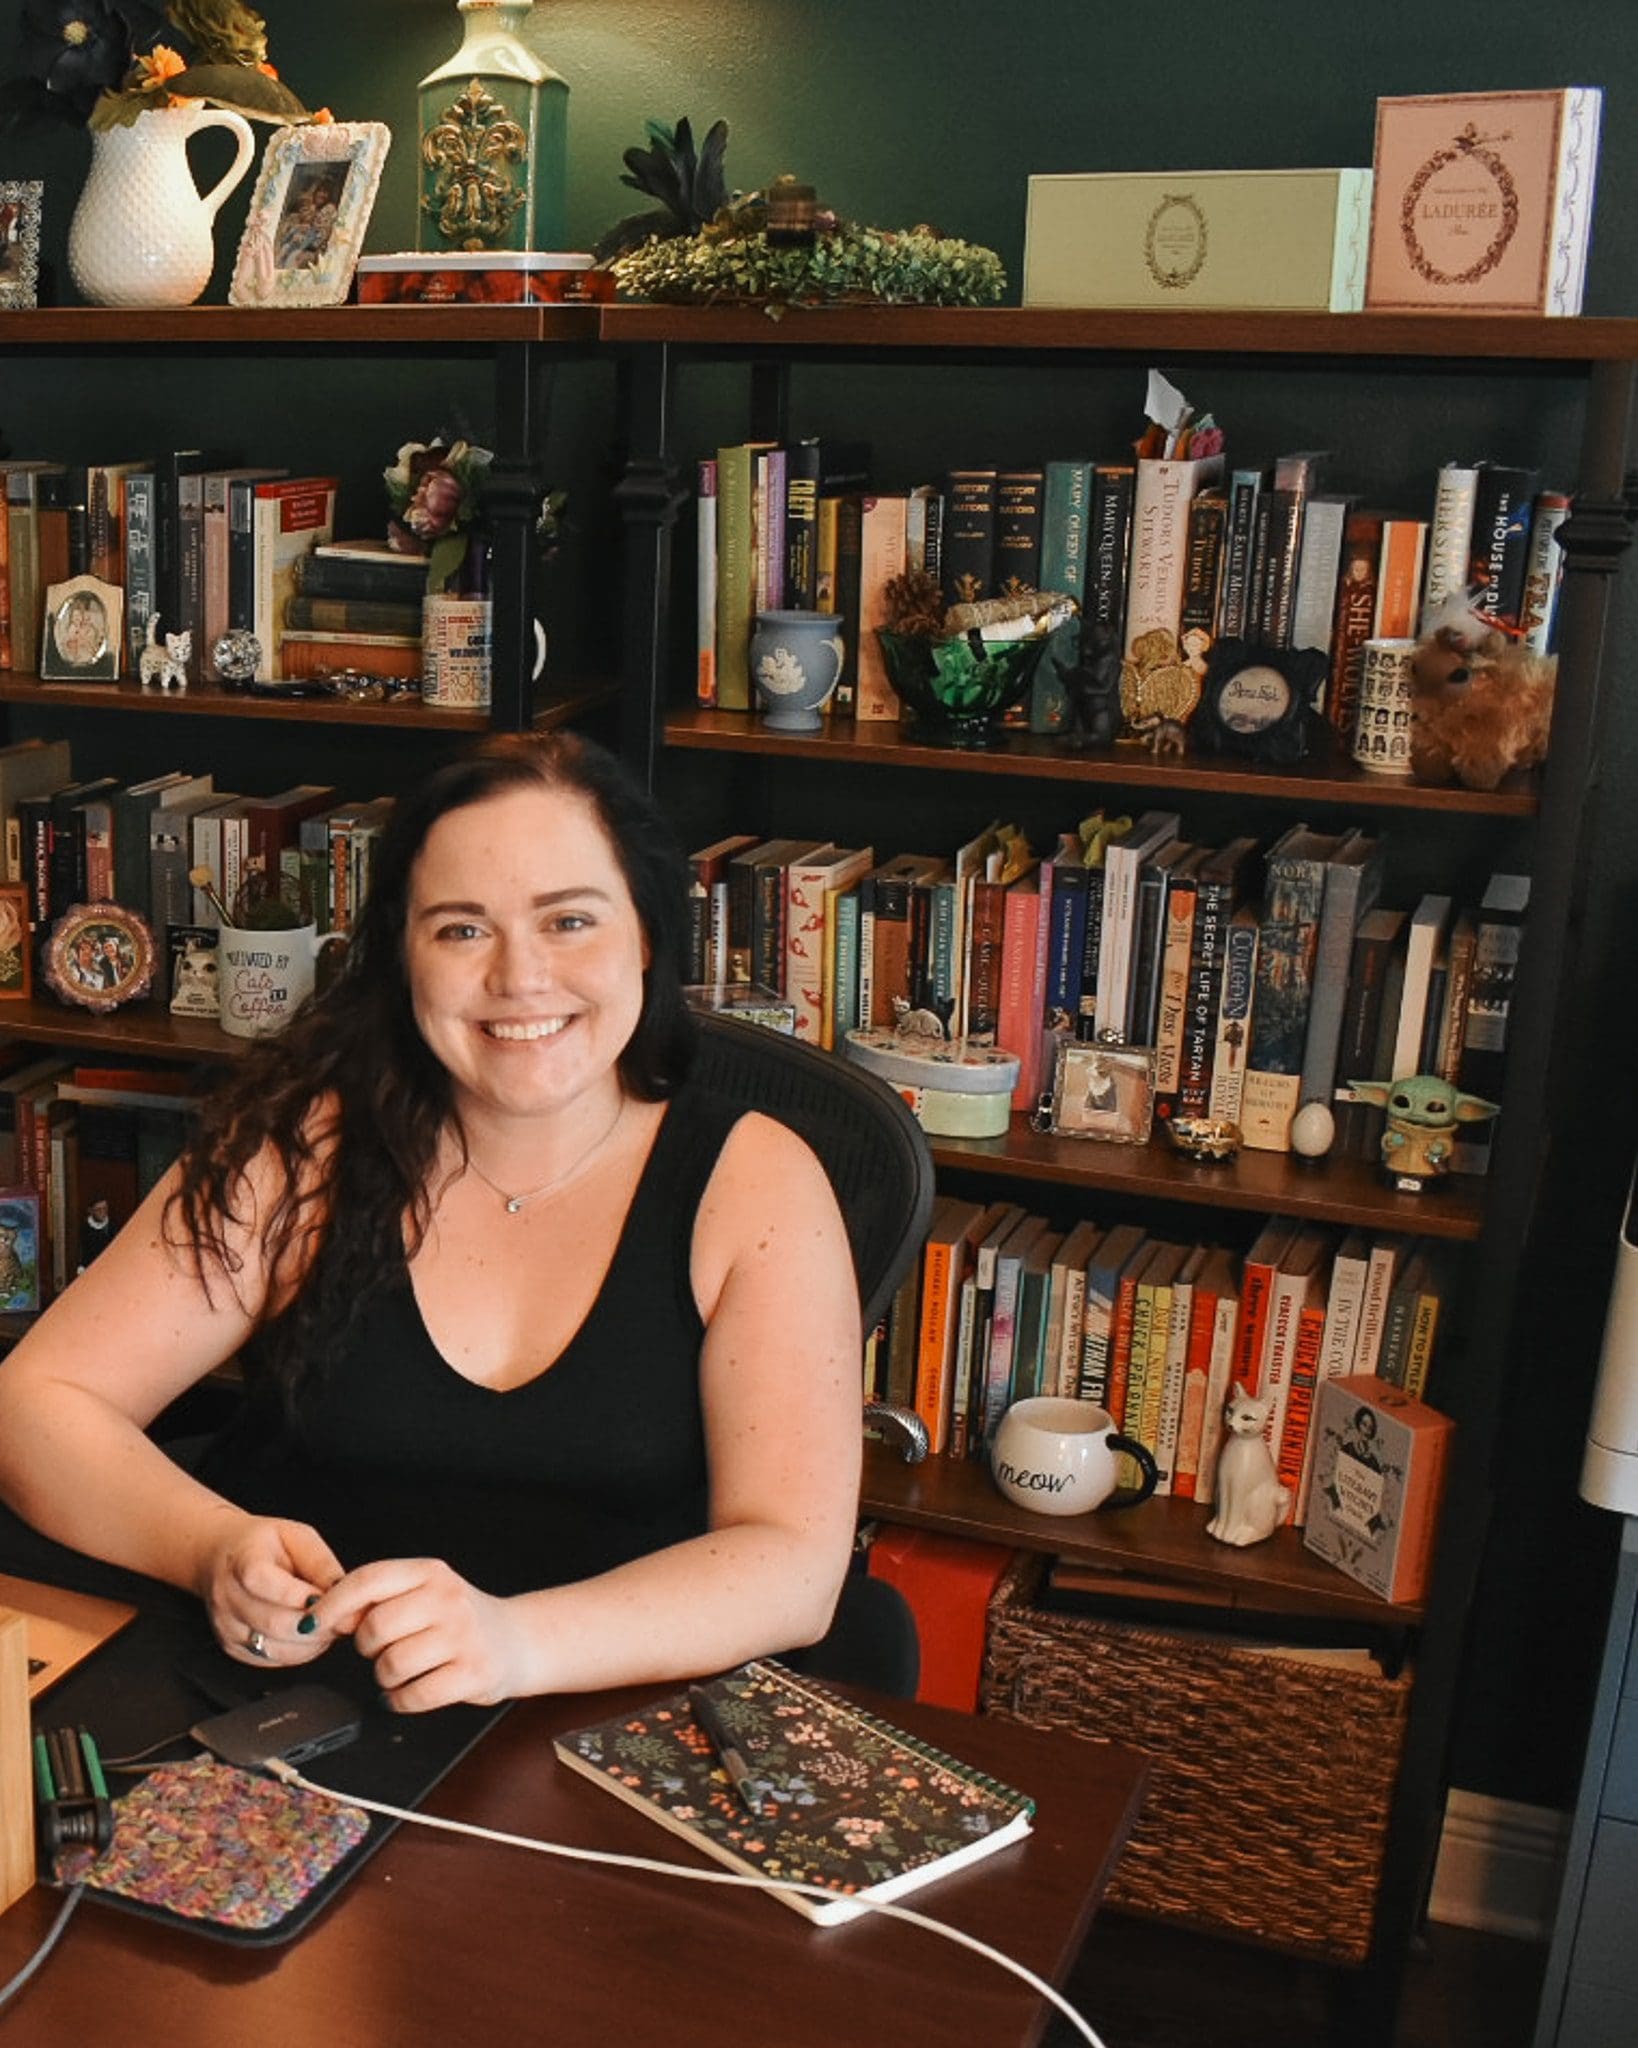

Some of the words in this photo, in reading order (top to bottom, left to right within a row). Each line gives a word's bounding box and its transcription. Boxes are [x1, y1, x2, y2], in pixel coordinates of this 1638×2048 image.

[1422, 201, 1499, 219] LADURÉE
[1070, 468, 1083, 509] MARY
[1103, 494, 1119, 535] MARY
[1158, 479, 1180, 547] TUDORS
[1066, 514, 1081, 560] QUEEN
[1097, 533, 1116, 580] QUEEN
[1136, 505, 1159, 591] STEWARTS
[1490, 516, 1509, 571] HOUSE
[1064, 566, 1078, 584] OF
[1524, 572, 1549, 627] TEA
[1205, 884, 1220, 911] THE
[1201, 915, 1218, 971] SECRET
[233, 969, 274, 995] Cats
[1197, 971, 1213, 1004] LIFE
[229, 993, 287, 1020] Coffee
[1195, 1007, 1208, 1023] OF
[1190, 1026, 1208, 1081] TARTAN
[930, 1250, 942, 1296] MICHAEL
[928, 1303, 940, 1344] POLLAN
[1132, 1299, 1151, 1353] CHUCK
[1277, 1295, 1292, 1338] REBECCA
[1339, 1299, 1352, 1319] IN
[1418, 1307, 1433, 1337] HOW
[1296, 1315, 1321, 1374] CHUCK
[1332, 1321, 1350, 1353] THE
[1359, 1304, 1379, 1365] Brilliance
[1416, 1338, 1428, 1353] TO
[1269, 1340, 1286, 1385] TRAISTER
[1409, 1354, 1424, 1387] STYLE
[1279, 1387, 1313, 1480] PALAHNIUK
[998, 1462, 1075, 1493] meow
